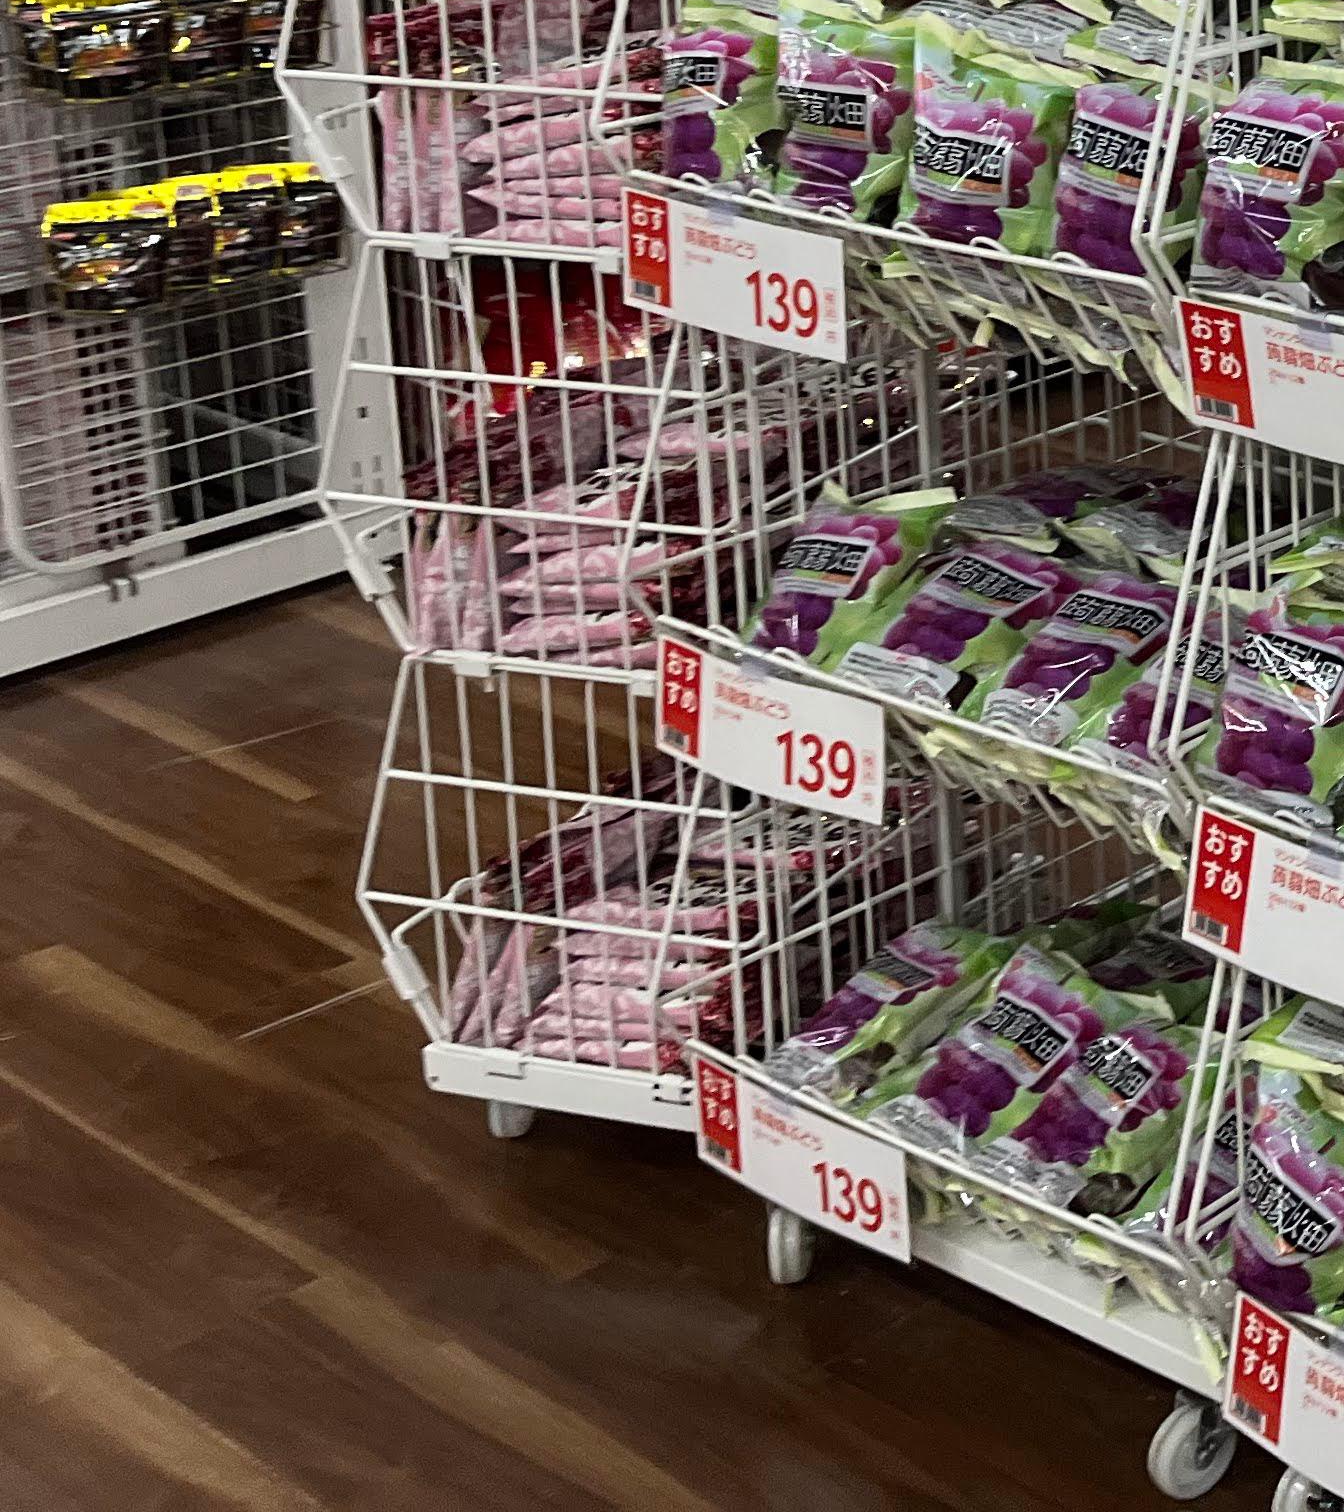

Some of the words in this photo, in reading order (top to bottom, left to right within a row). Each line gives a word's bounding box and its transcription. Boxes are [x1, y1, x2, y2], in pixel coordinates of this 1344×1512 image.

[1204, 117, 1309, 170] 蒟蒻畑
[746, 269, 818, 339] 139
[1189, 310, 1237, 345] おす
[1193, 344, 1243, 380] すめ
[775, 730, 858, 799] 139
[1204, 823, 1249, 864] おす
[1201, 860, 1245, 901] すめ
[811, 1160, 883, 1233] 139
[1244, 1311, 1285, 1356] おす
[1241, 1346, 1281, 1392] すめ
